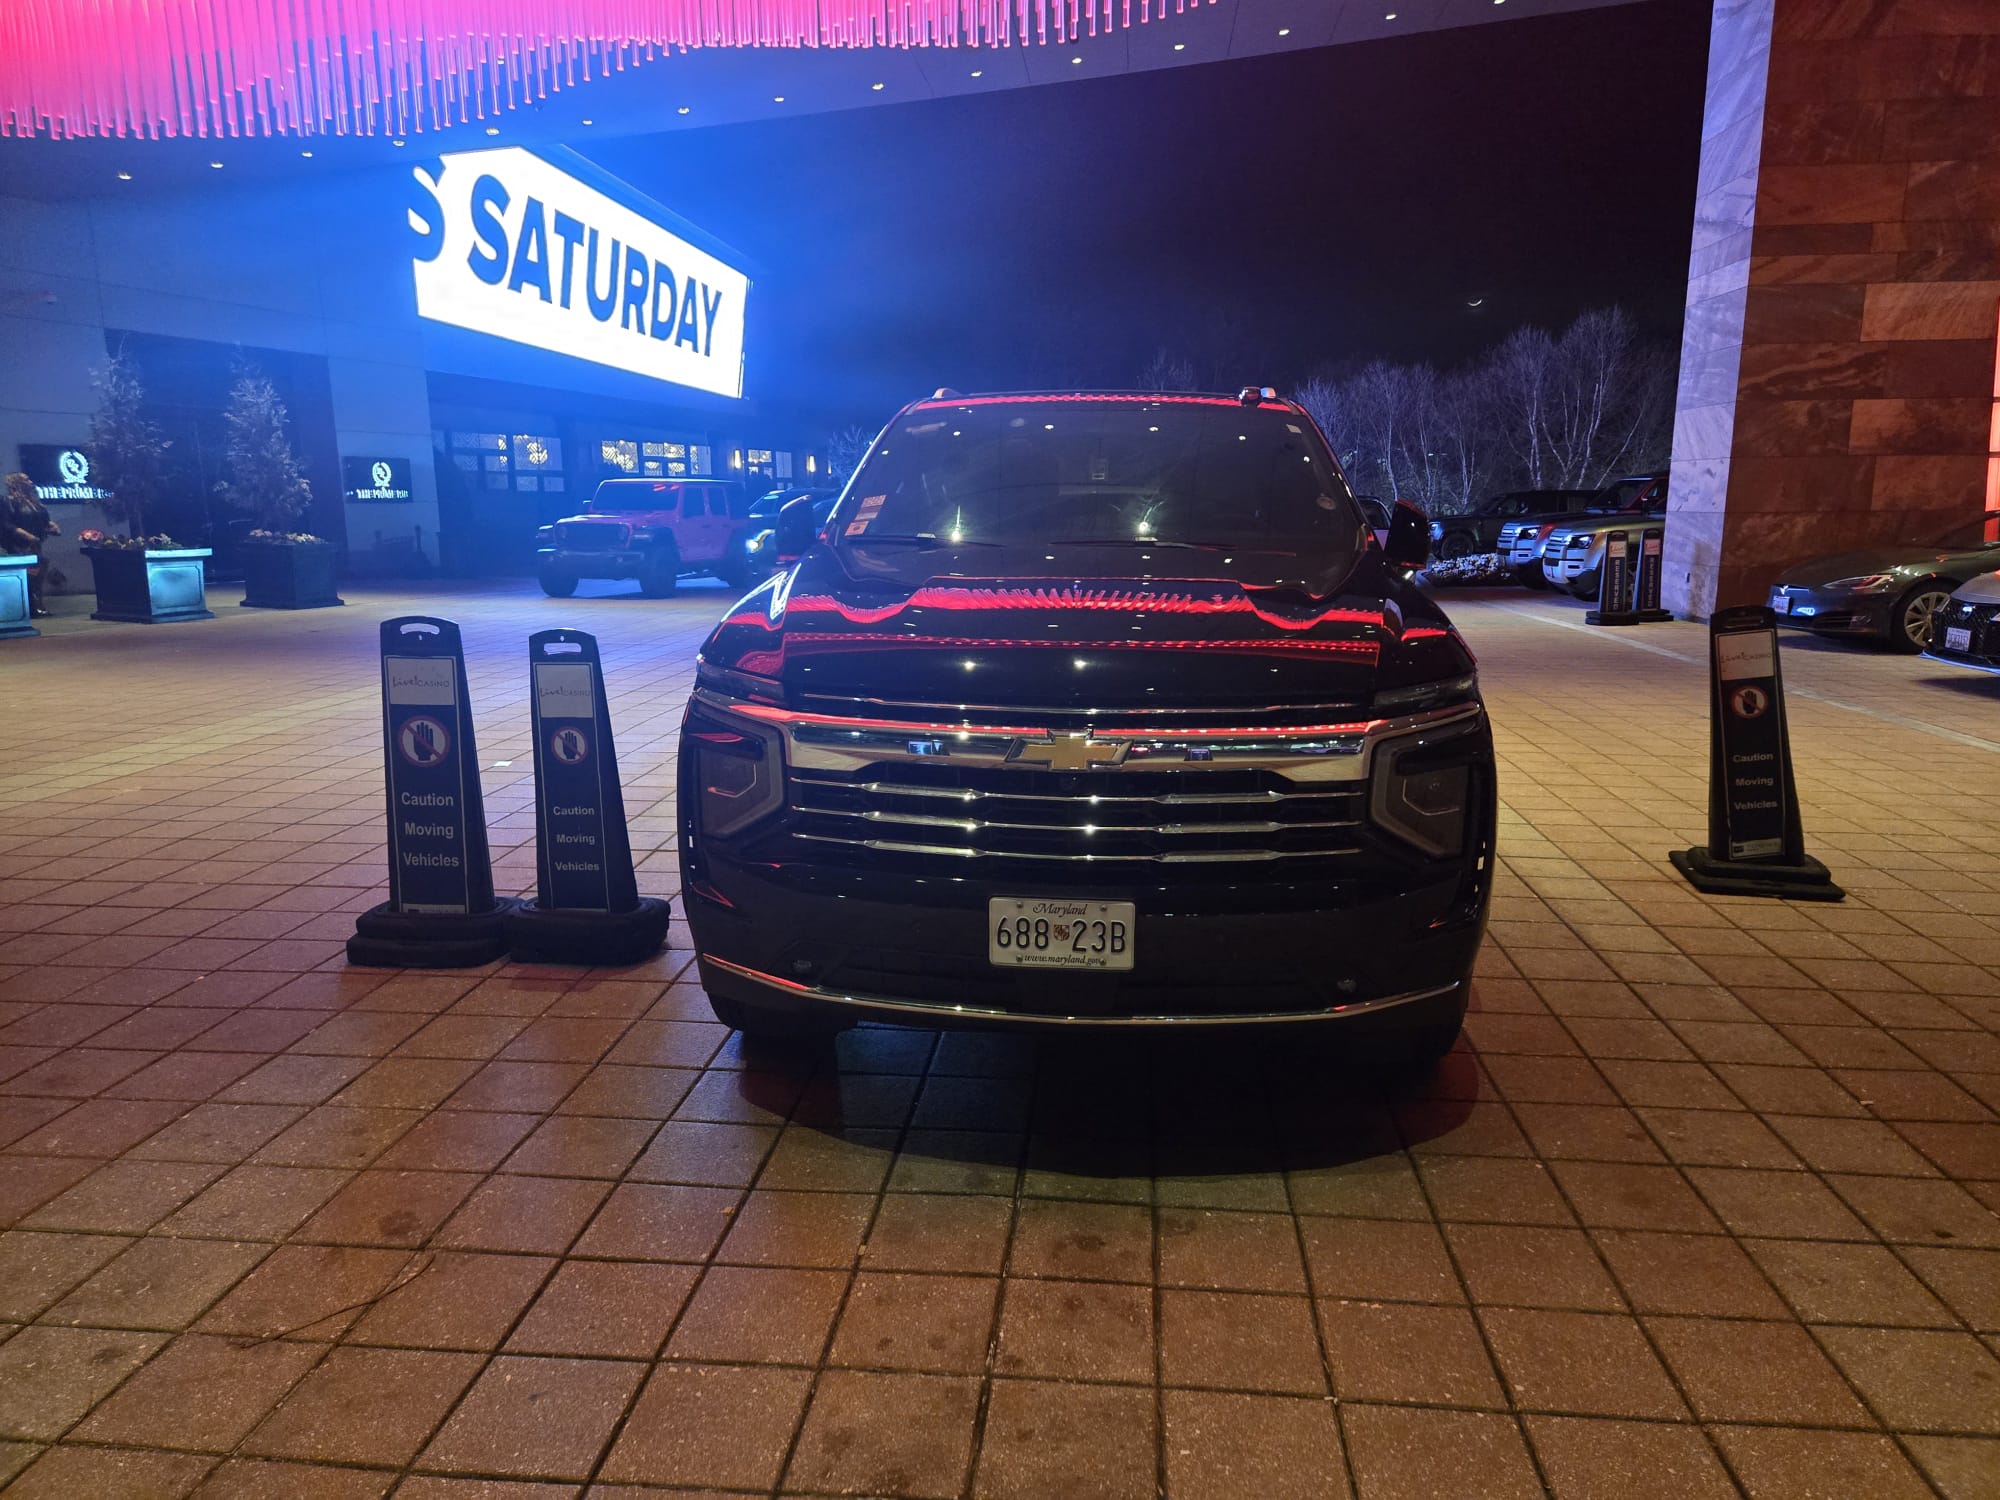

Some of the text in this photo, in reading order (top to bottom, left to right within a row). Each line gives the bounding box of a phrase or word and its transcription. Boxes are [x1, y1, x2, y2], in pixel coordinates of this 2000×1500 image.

[467, 173, 723, 358] SATURDAY
[1732, 752, 1774, 763] Caution
[1735, 776, 1774, 787] Moving
[401, 791, 454, 807] Caution
[1733, 800, 1778, 811] Vehicles
[553, 805, 595, 816] Caution
[404, 822, 454, 840] Moving
[556, 833, 596, 846] Moving
[402, 852, 460, 868] Vehicles
[555, 861, 600, 872] Vehicles
[1032, 903, 1088, 918] Maryland
[996, 915, 1127, 954] 688 23B
